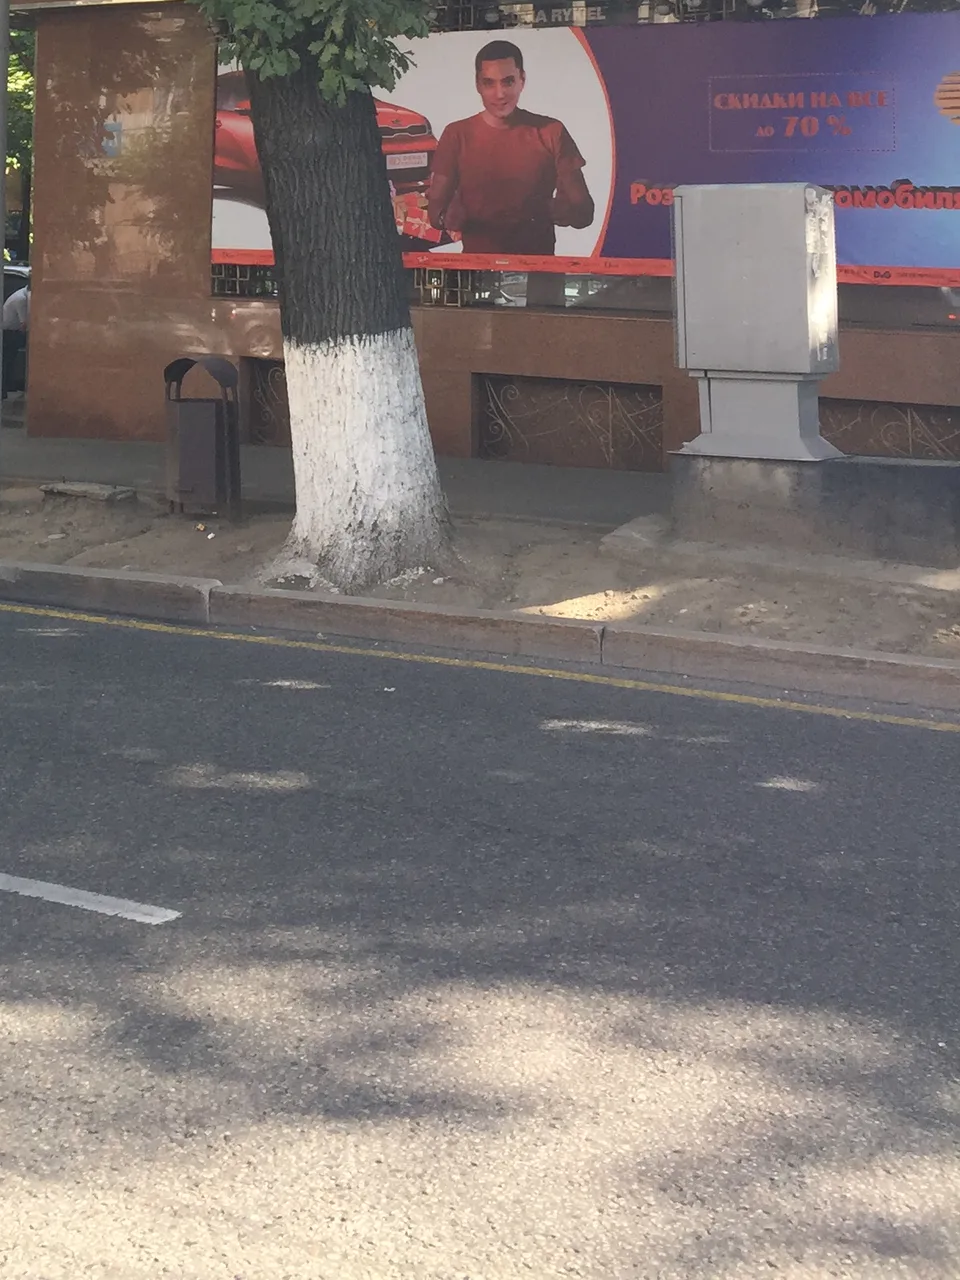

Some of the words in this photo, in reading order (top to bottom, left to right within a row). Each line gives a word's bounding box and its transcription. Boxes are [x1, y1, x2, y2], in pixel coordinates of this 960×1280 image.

[713, 91, 805, 110] СКИДКИ
[809, 91, 842, 108] НА
[846, 90, 889, 108] ВСЕ
[782, 115, 820, 138] 70
[630, 183, 675, 206] Роз
